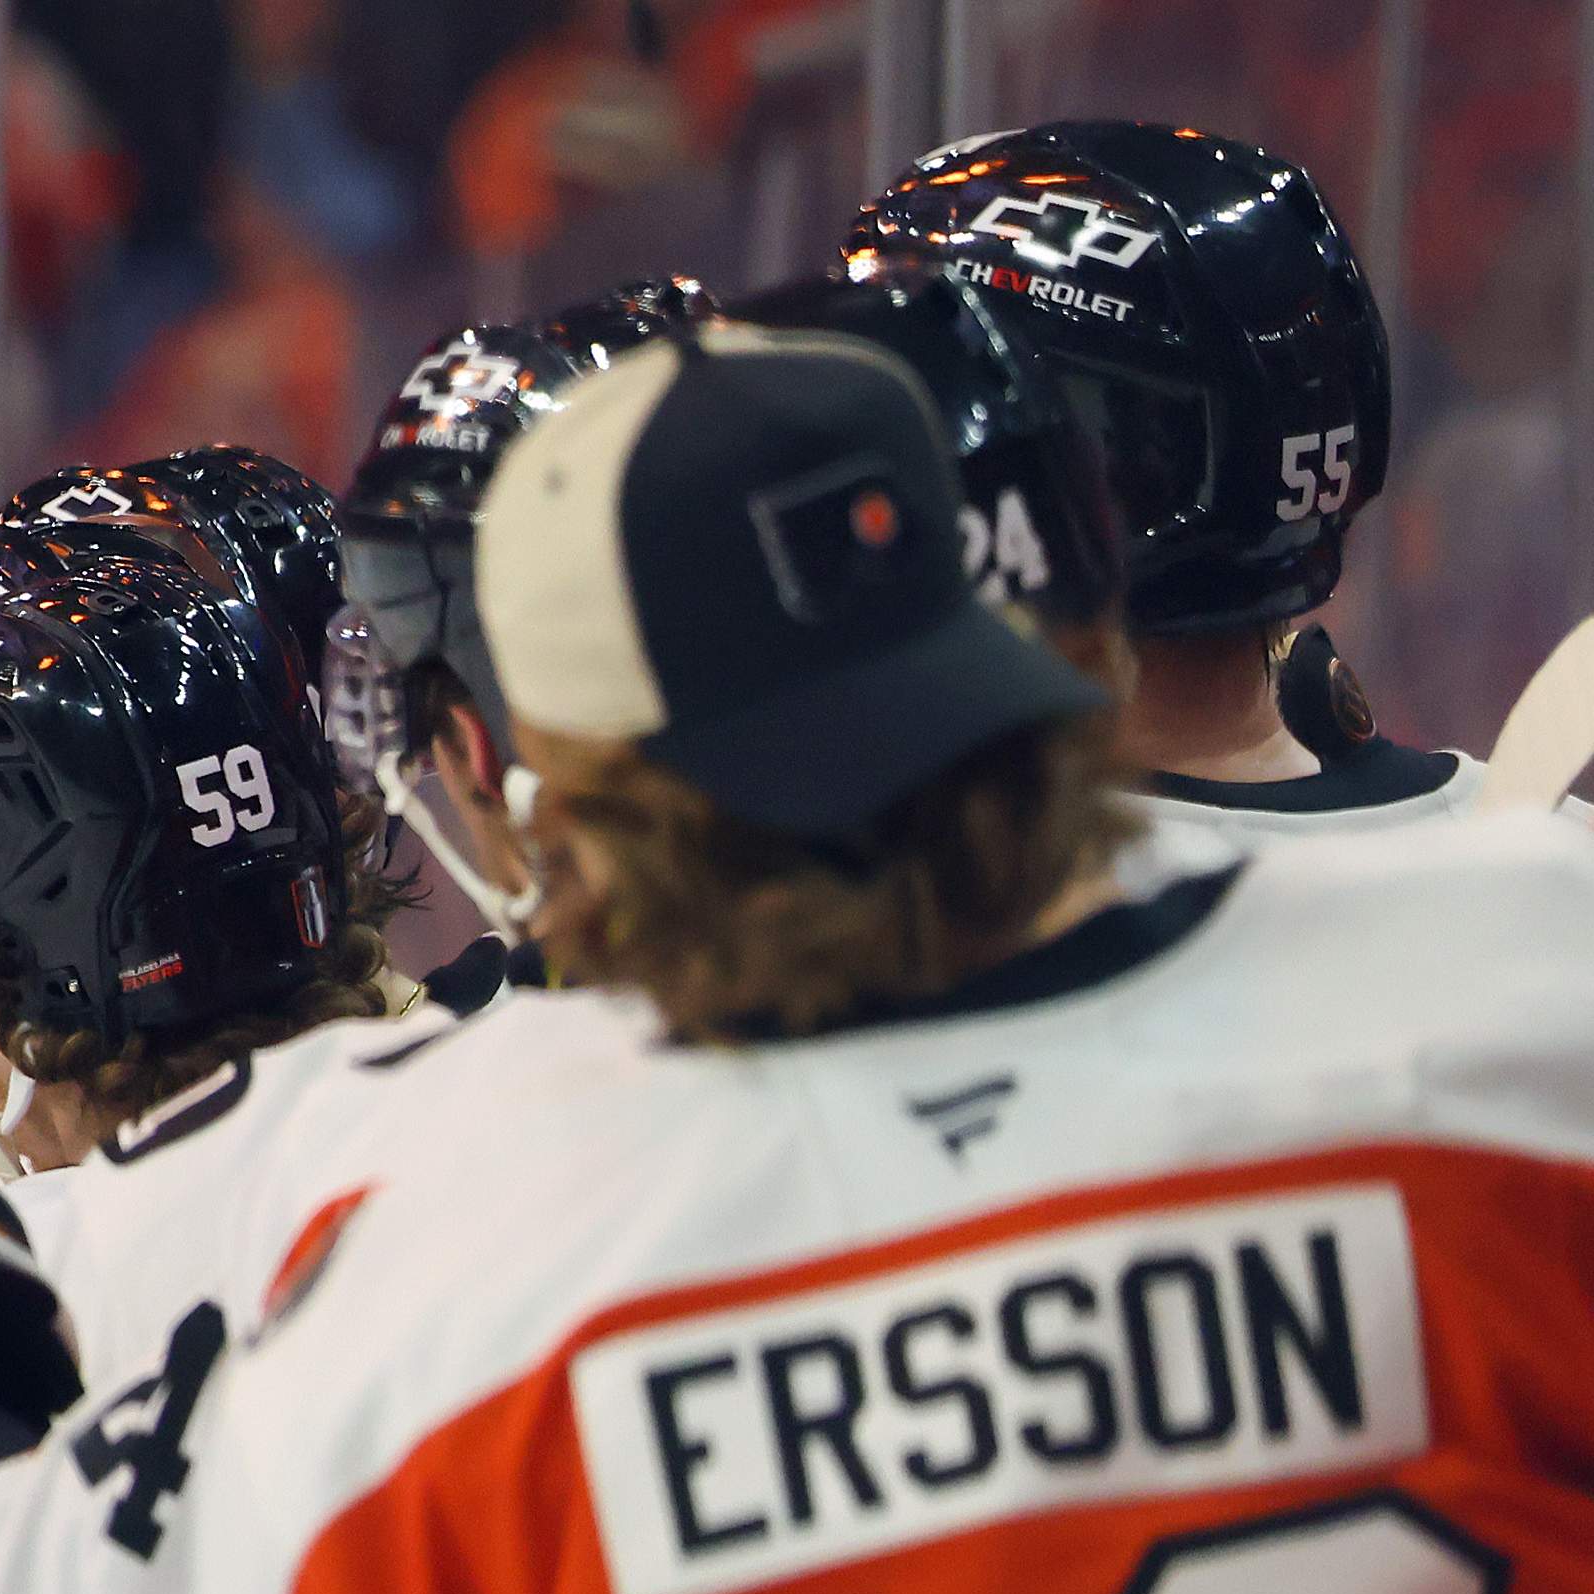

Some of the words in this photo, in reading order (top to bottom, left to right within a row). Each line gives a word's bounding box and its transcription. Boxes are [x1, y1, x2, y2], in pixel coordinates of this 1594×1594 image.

[954, 257, 1134, 322] CHEVROLET
[1276, 424, 1355, 523] 55
[176, 744, 276, 848] 59
[642, 1225, 1364, 1560] ERSSON
